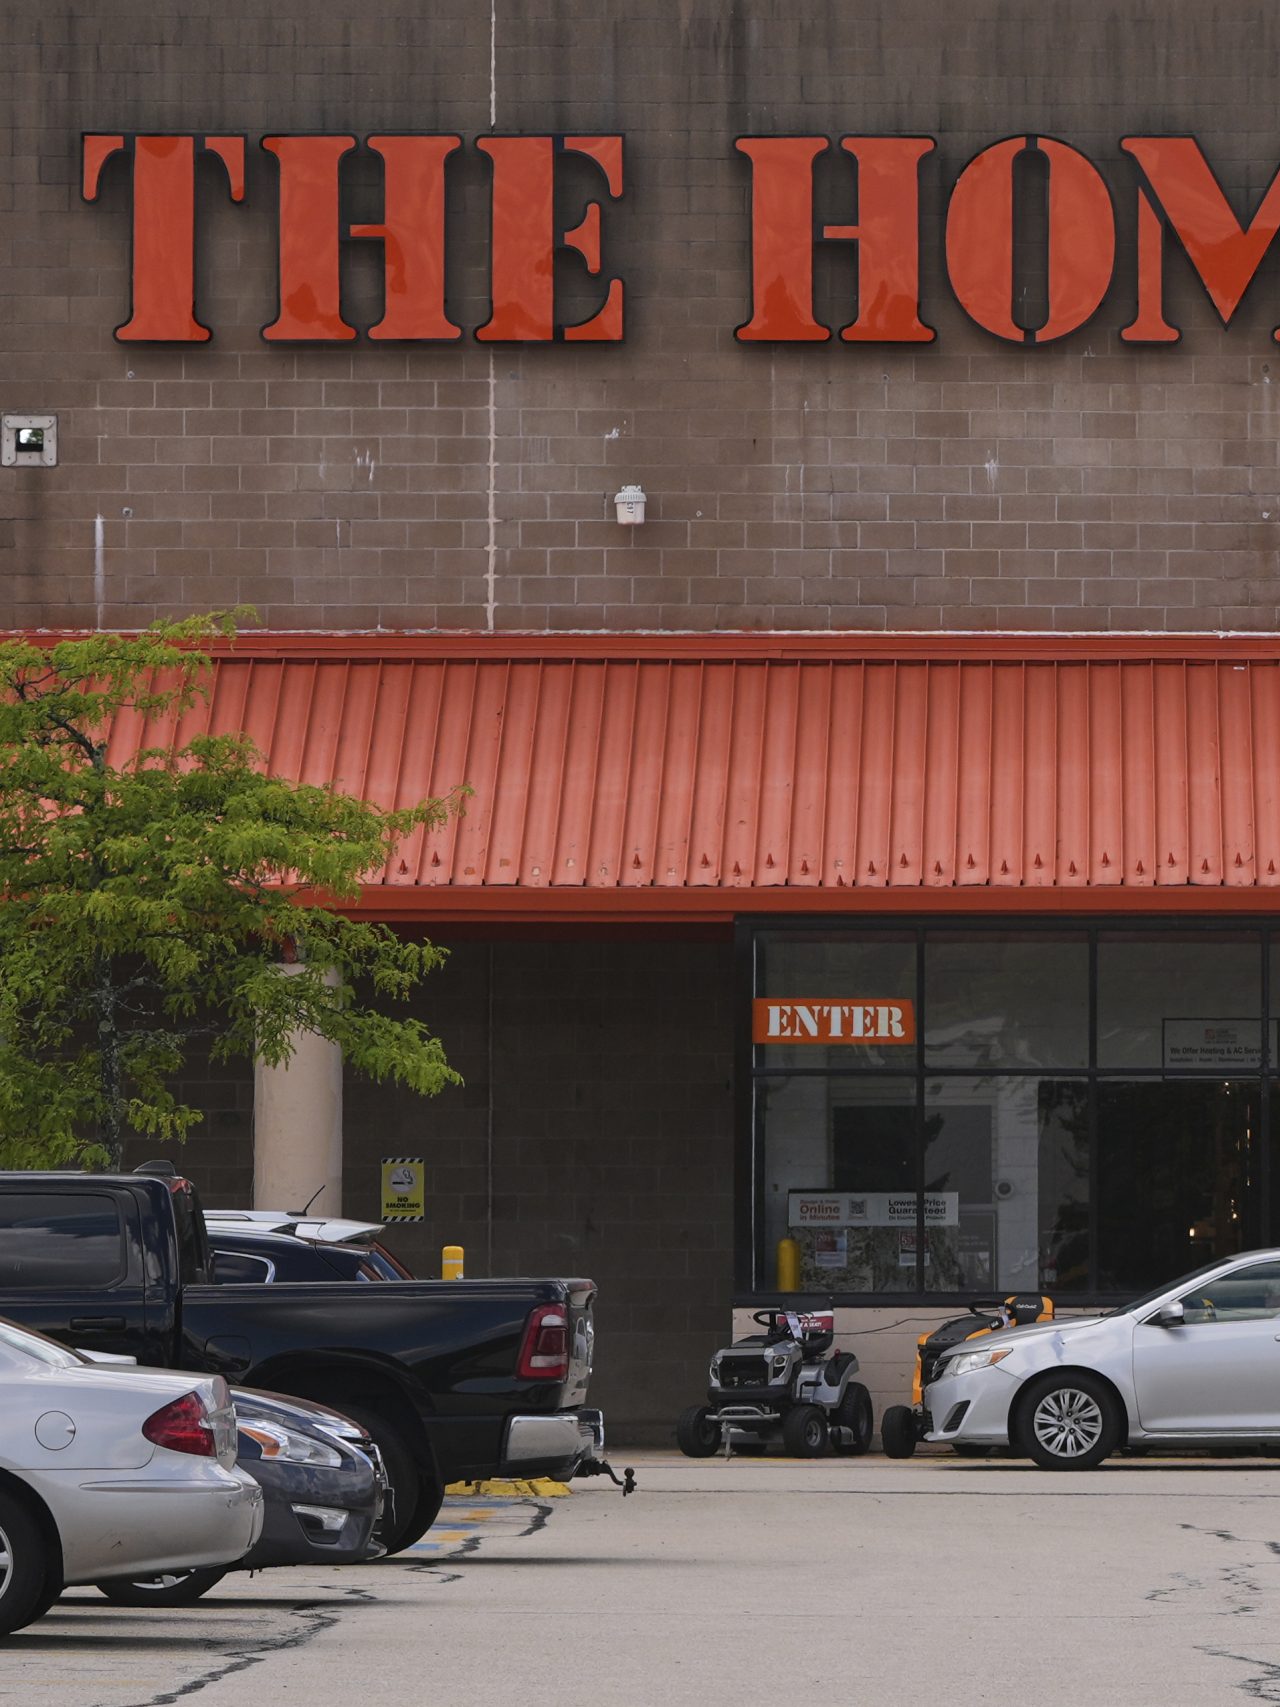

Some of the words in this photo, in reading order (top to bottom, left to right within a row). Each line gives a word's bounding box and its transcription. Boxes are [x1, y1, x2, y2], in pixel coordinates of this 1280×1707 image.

[81, 131, 626, 346] THE
[766, 1005, 906, 1038] ENTER
[800, 1204, 840, 1215] Online
